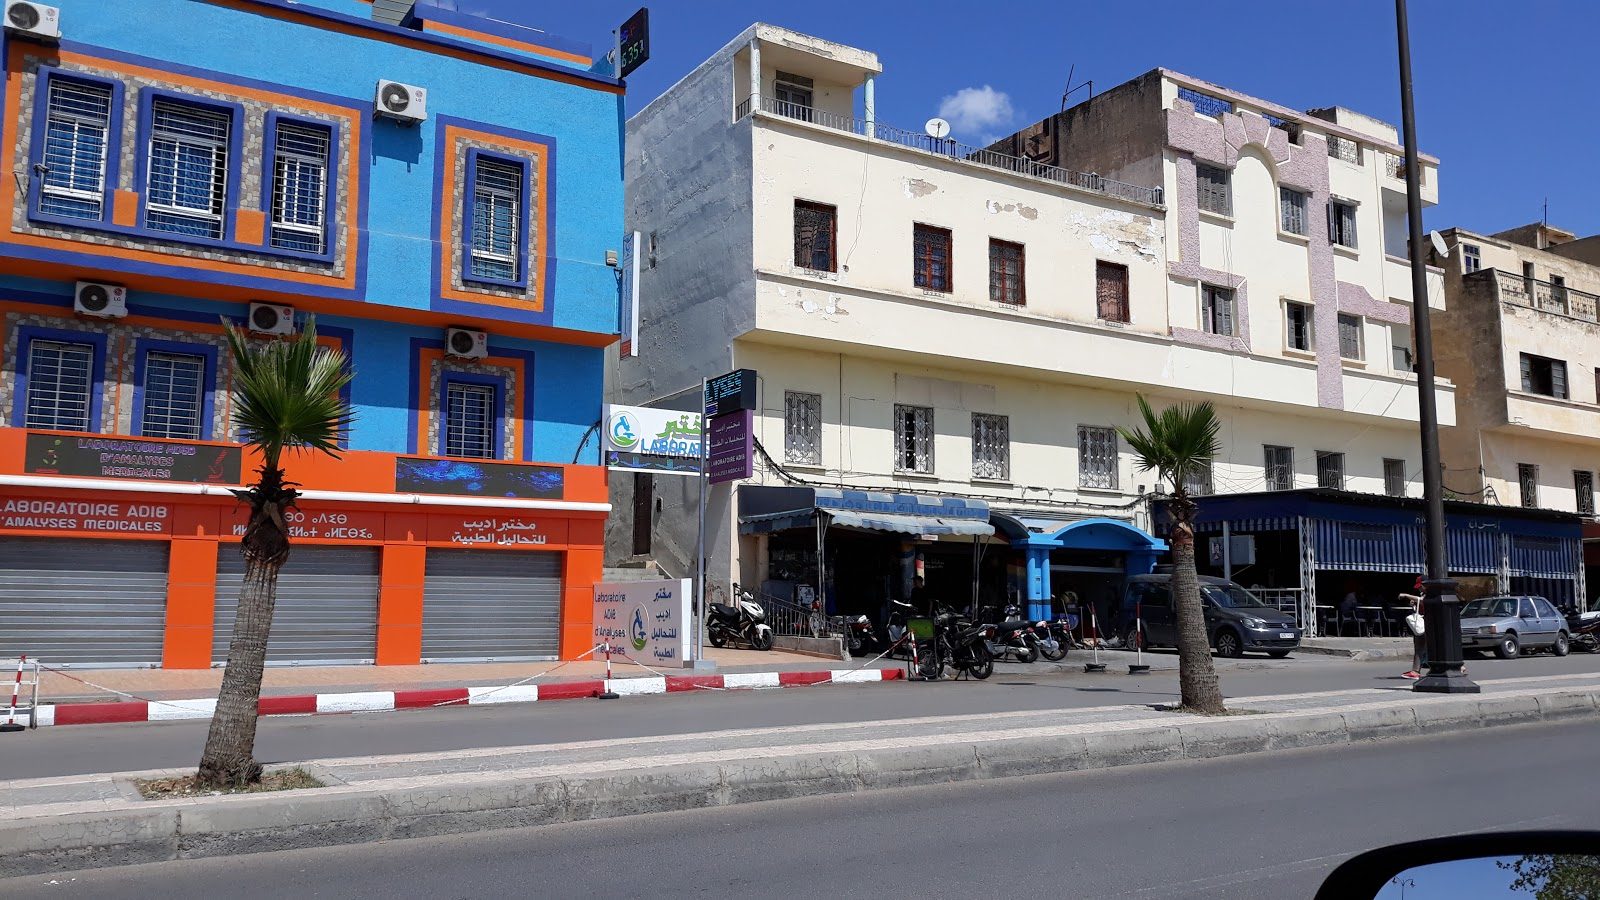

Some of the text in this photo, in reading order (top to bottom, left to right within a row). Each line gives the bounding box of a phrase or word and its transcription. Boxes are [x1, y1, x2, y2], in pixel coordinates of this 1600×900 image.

[78, 438, 164, 454] LABORATOIRE
[100, 453, 175, 467] D'ANALYSES
[101, 466, 172, 479] MEDICALES
[127, 505, 168, 518] ADIB
[0, 515, 162, 532] 'ANALYSES MEDICALES
[463, 518, 536, 532] مختبر اديب
[452, 531, 546, 546] للتحاليل الطبية
[594, 592, 626, 603] Laboratoire
[653, 587, 672, 602] مختبر
[603, 608, 617, 620] ADIB
[655, 608, 671, 622] اديب
[594, 625, 626, 640] d'Analyses
[651, 627, 677, 642] للتحاليل
[653, 646, 675, 661] الطبية
